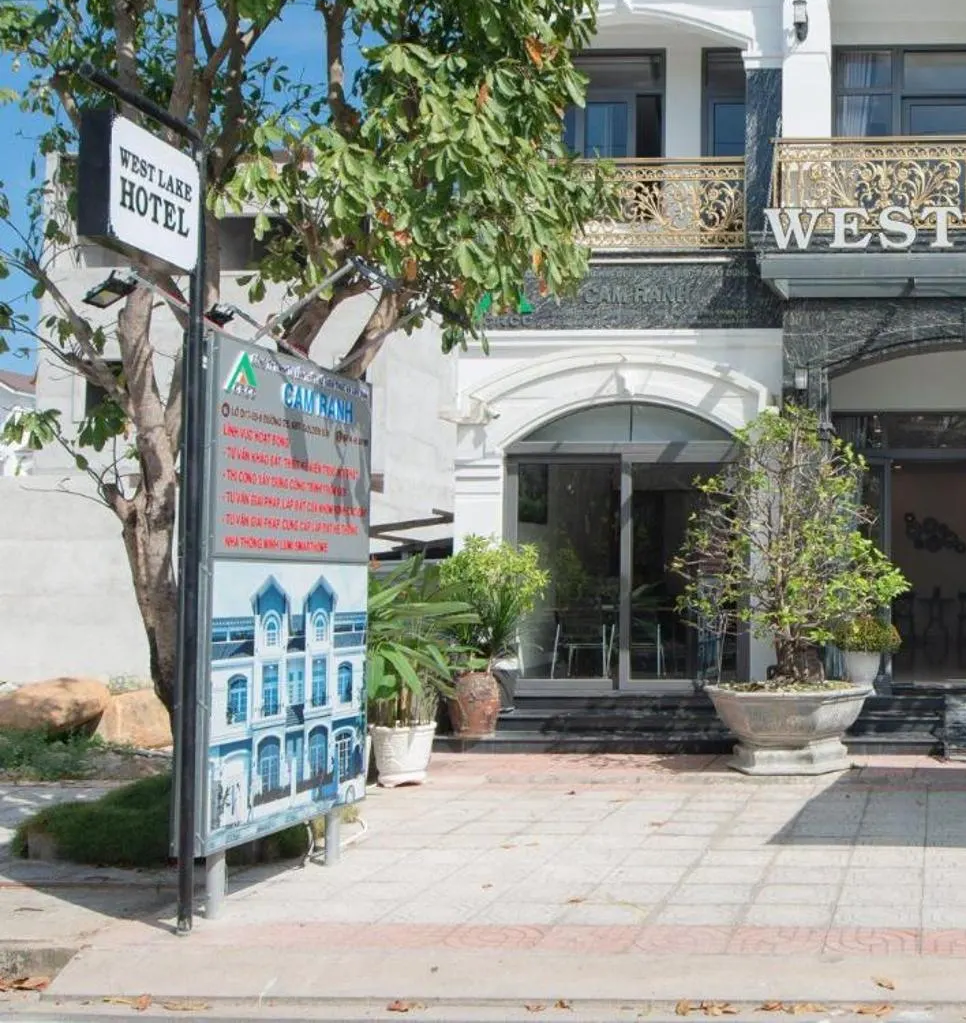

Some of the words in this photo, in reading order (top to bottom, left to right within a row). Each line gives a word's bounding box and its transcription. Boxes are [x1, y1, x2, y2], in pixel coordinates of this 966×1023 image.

[120, 146, 155, 182] WEST
[158, 169, 192, 202] LAKE
[120, 176, 190, 237] HOTEL
[764, 206, 963, 249] WEST
